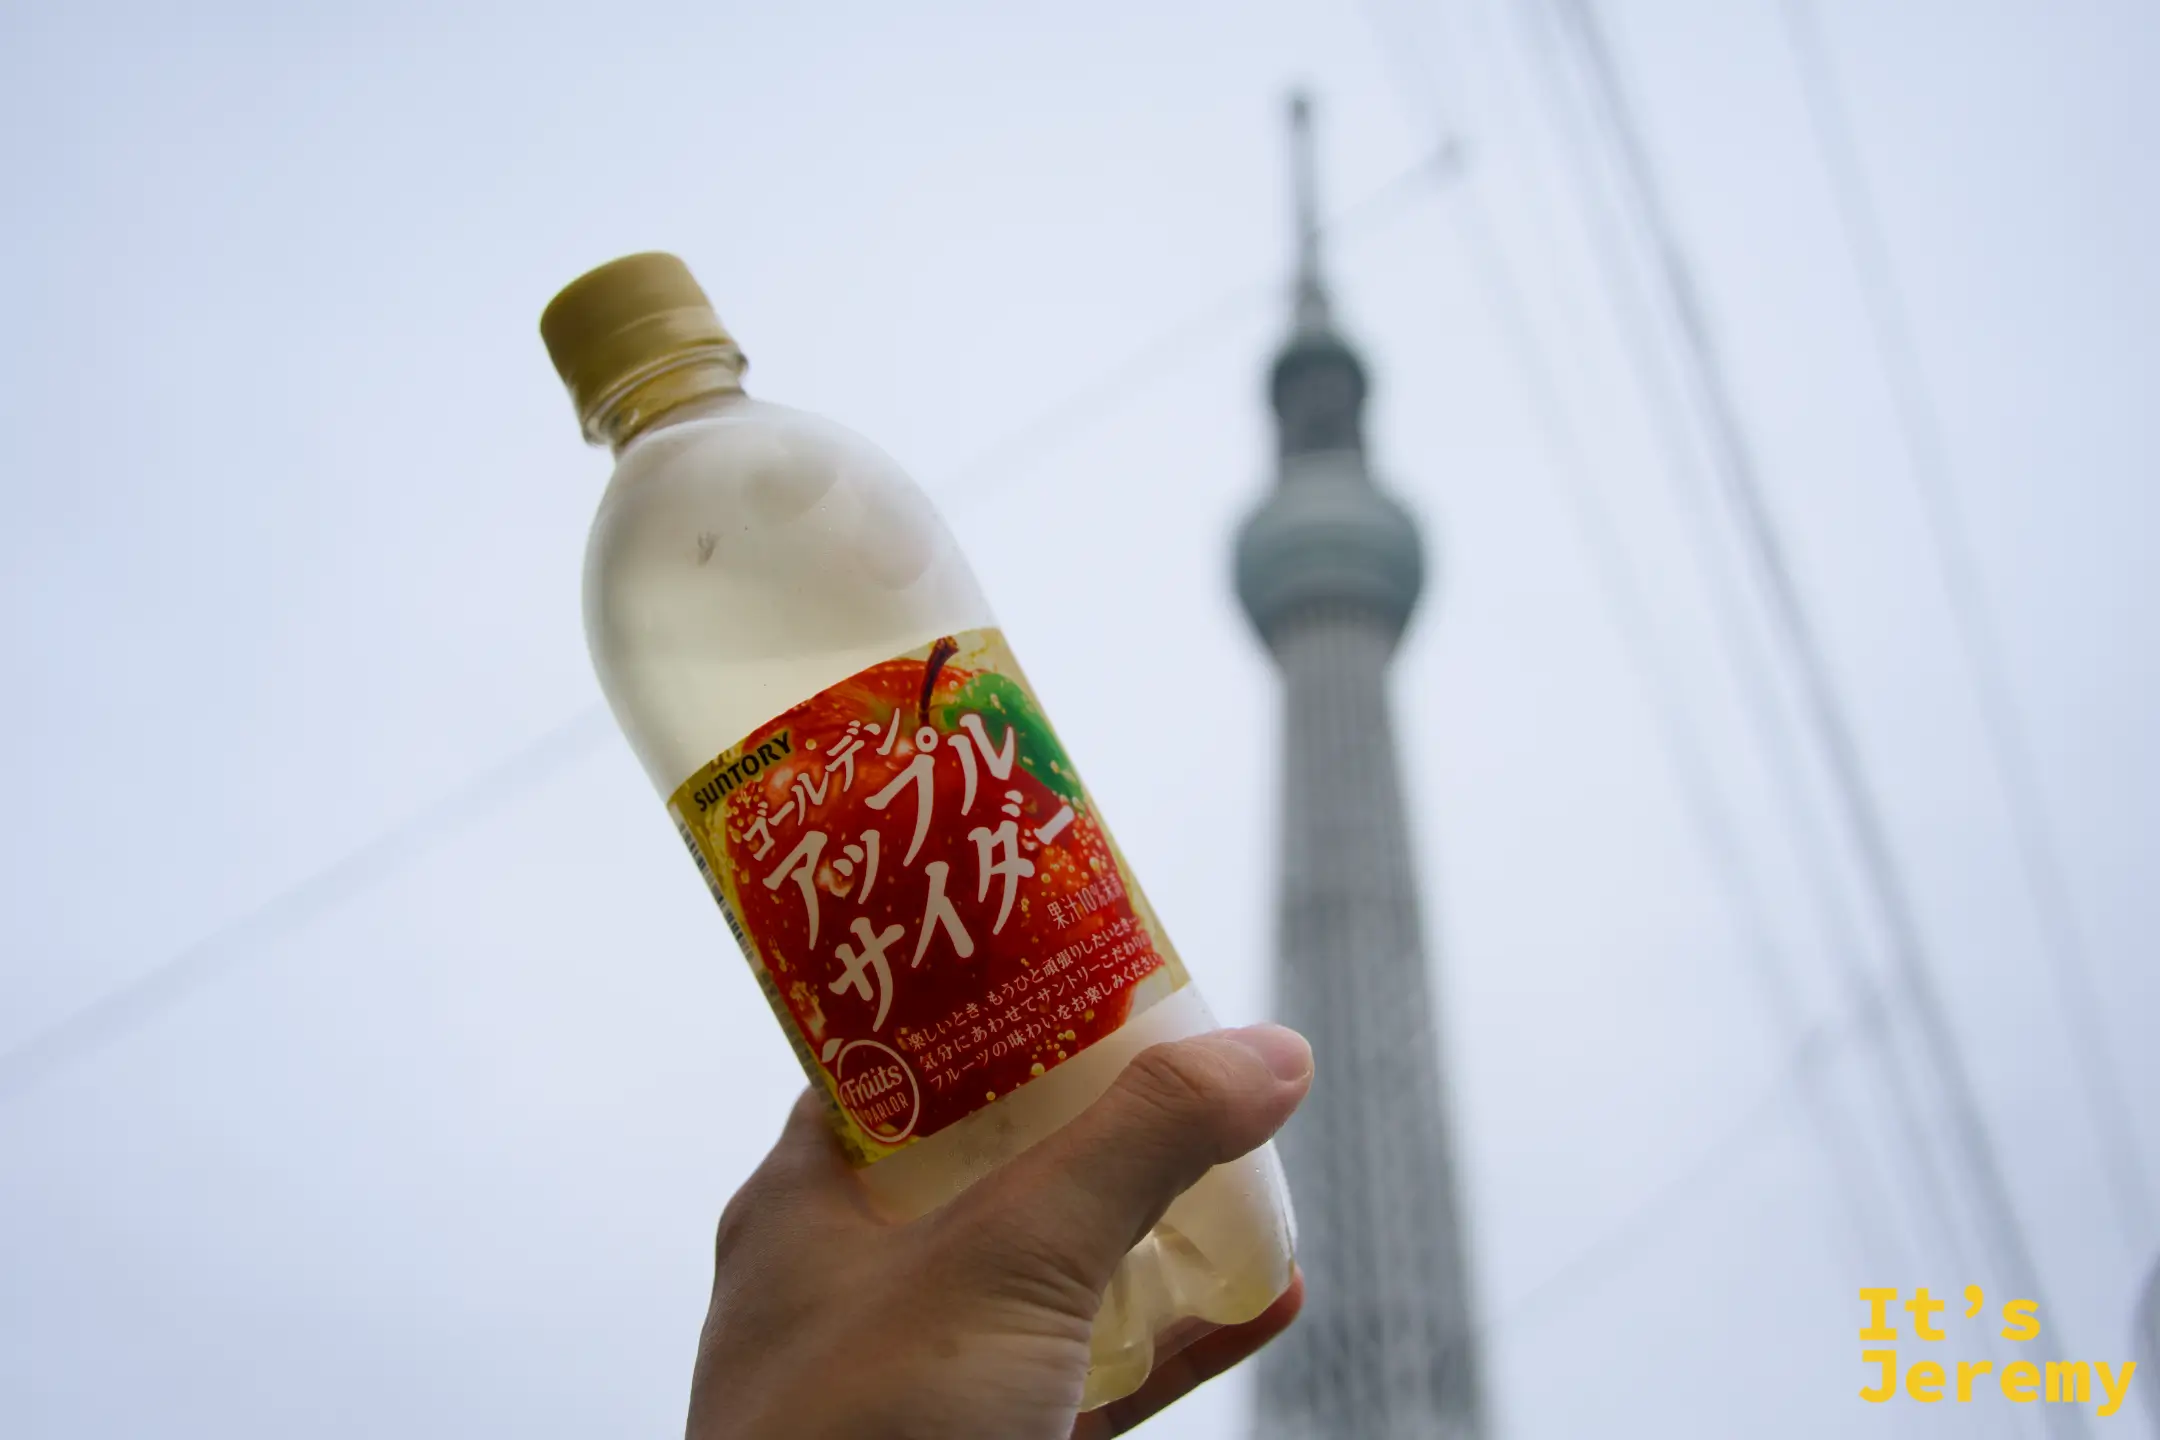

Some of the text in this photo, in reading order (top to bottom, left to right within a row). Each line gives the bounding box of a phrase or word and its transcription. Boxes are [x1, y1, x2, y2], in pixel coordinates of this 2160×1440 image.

[743, 708, 900, 861] ゴールデン
[763, 713, 1014, 950] アップル
[829, 790, 1075, 1032] サイダー
[840, 1065, 903, 1107] Fruits
[864, 1092, 909, 1126] PARLOR
